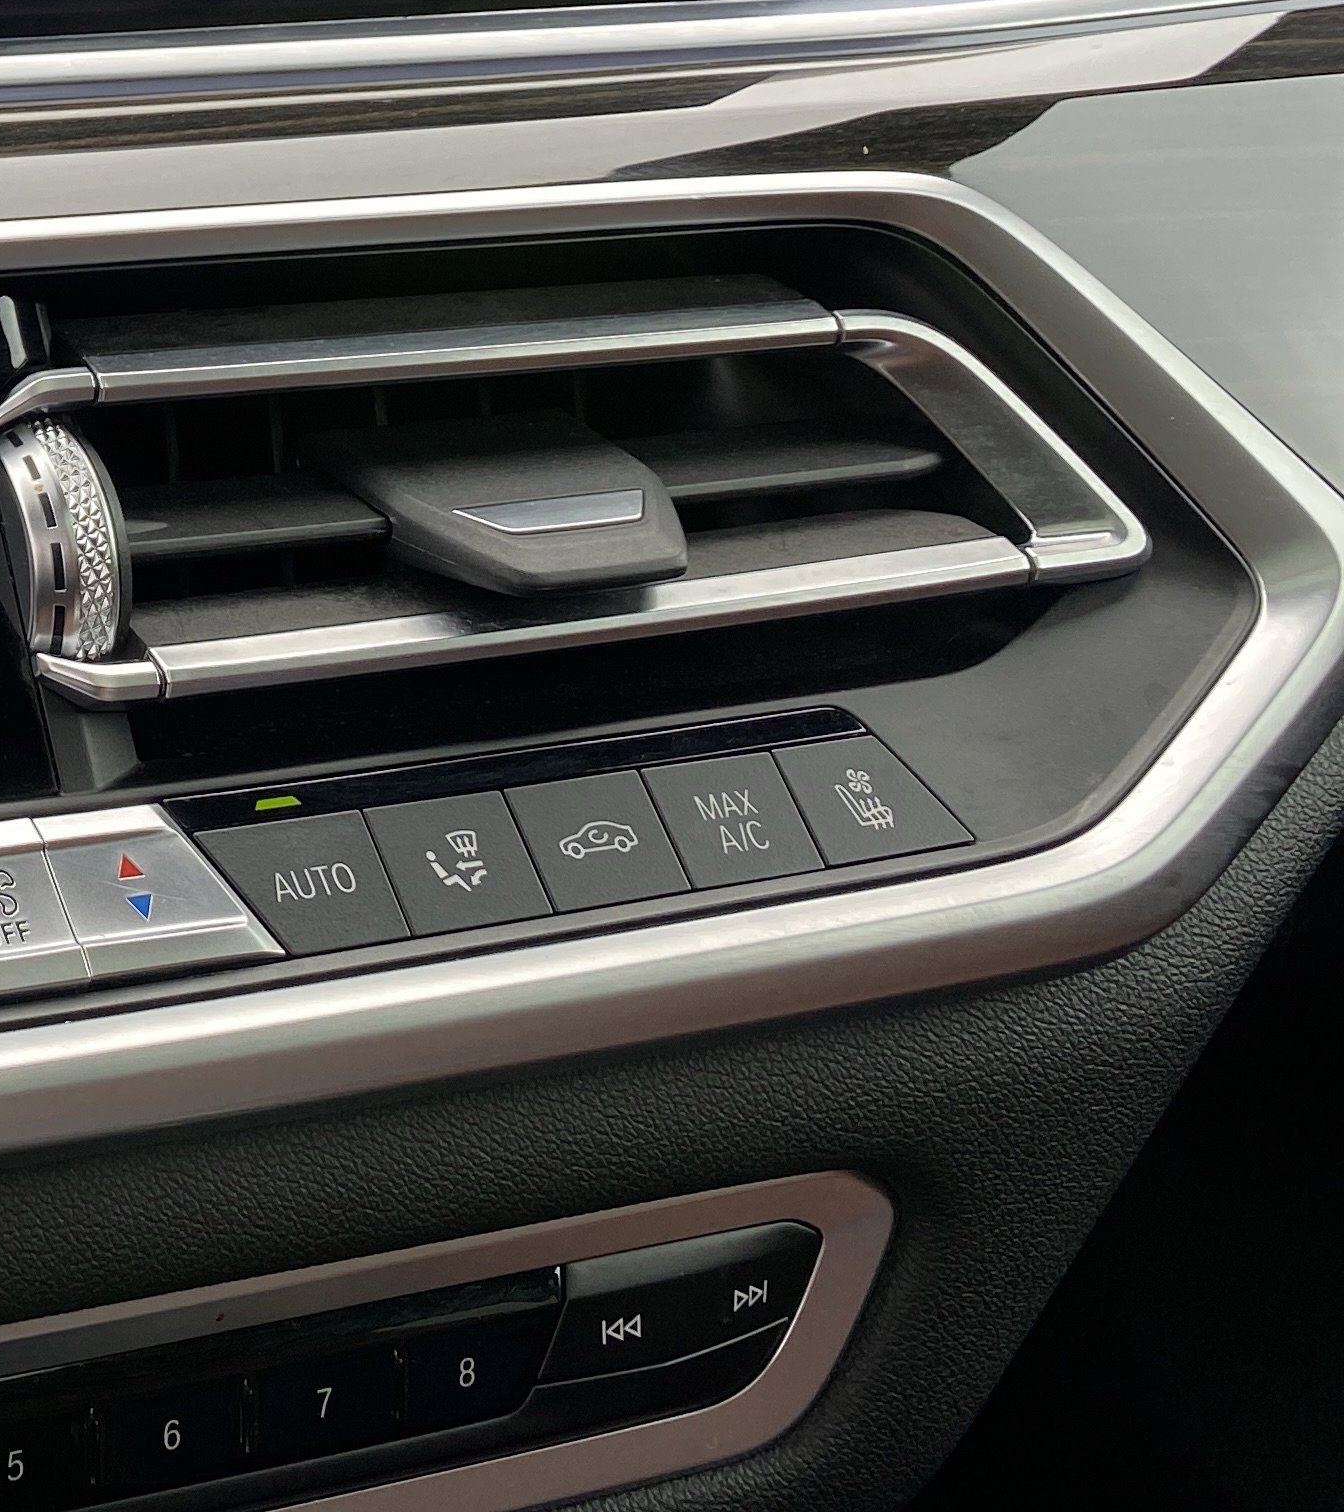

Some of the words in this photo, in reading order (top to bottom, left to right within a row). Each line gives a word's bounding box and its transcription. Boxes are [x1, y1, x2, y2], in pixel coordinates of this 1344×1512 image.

[693, 789, 758, 821] MAX
[719, 820, 770, 854] A/C
[275, 862, 357, 903] AUTO
[459, 1357, 476, 1388] 8
[316, 1387, 333, 1418] 7
[163, 1419, 181, 1451] 6
[7, 1449, 24, 1481] 5
